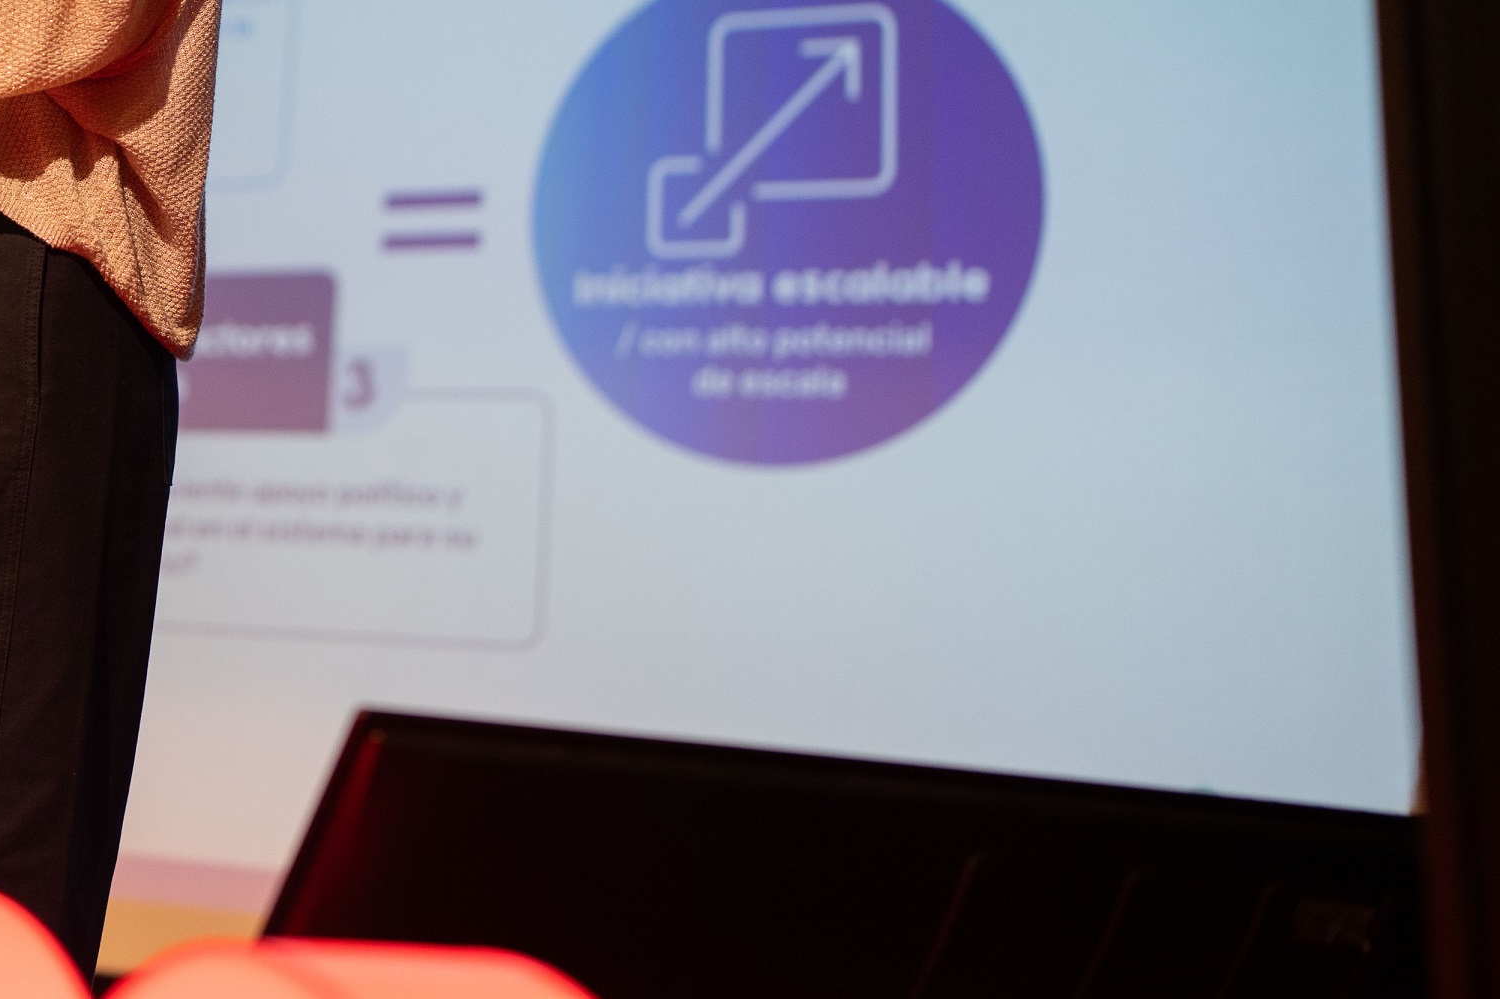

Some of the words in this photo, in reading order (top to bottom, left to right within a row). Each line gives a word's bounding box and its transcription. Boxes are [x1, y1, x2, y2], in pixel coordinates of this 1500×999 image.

[573, 265, 765, 305] Iniciativa
[772, 259, 993, 305] escalable
[638, 327, 698, 357] con
[706, 322, 768, 357] alto
[772, 319, 934, 361] potencial
[344, 356, 377, 412] 3
[691, 366, 733, 399] de
[739, 364, 849, 399] escala
